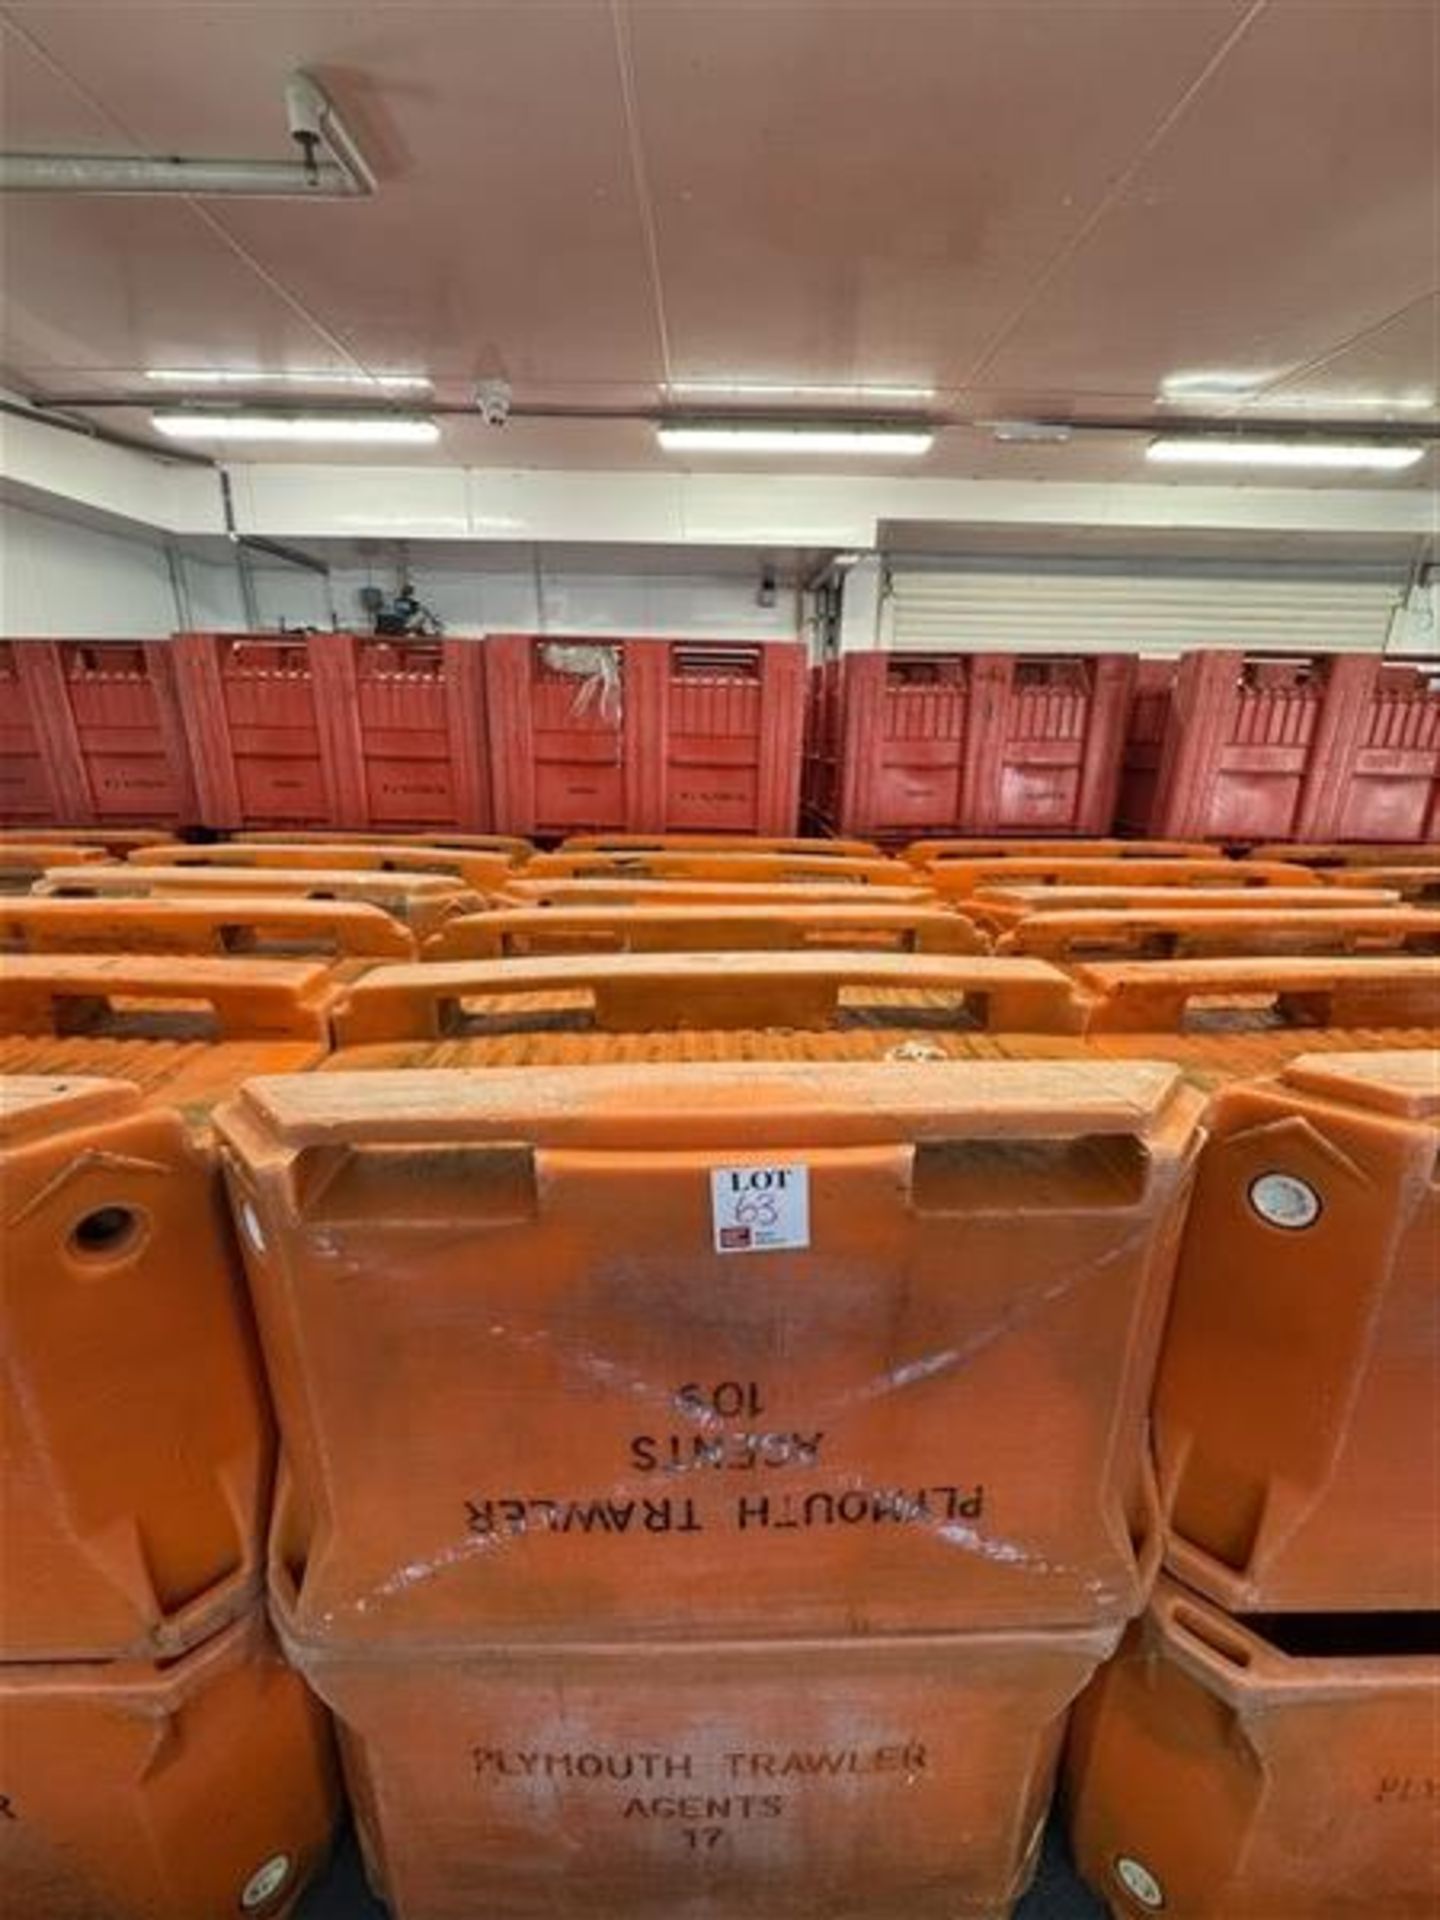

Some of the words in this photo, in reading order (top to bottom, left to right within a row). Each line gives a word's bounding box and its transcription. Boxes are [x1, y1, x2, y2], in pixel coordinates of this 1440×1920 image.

[731, 1168, 793, 1192] LOT
[735, 1193, 778, 1226] 63
[465, 1499, 702, 1534] TRAWLER
[739, 1486, 983, 1530] PLYMOUTH
[473, 1747, 692, 1779] PLYMOUTH
[726, 1742, 927, 1777] TRAWLER
[622, 1795, 783, 1819] AGENTS
[682, 1828, 722, 1849] 17
